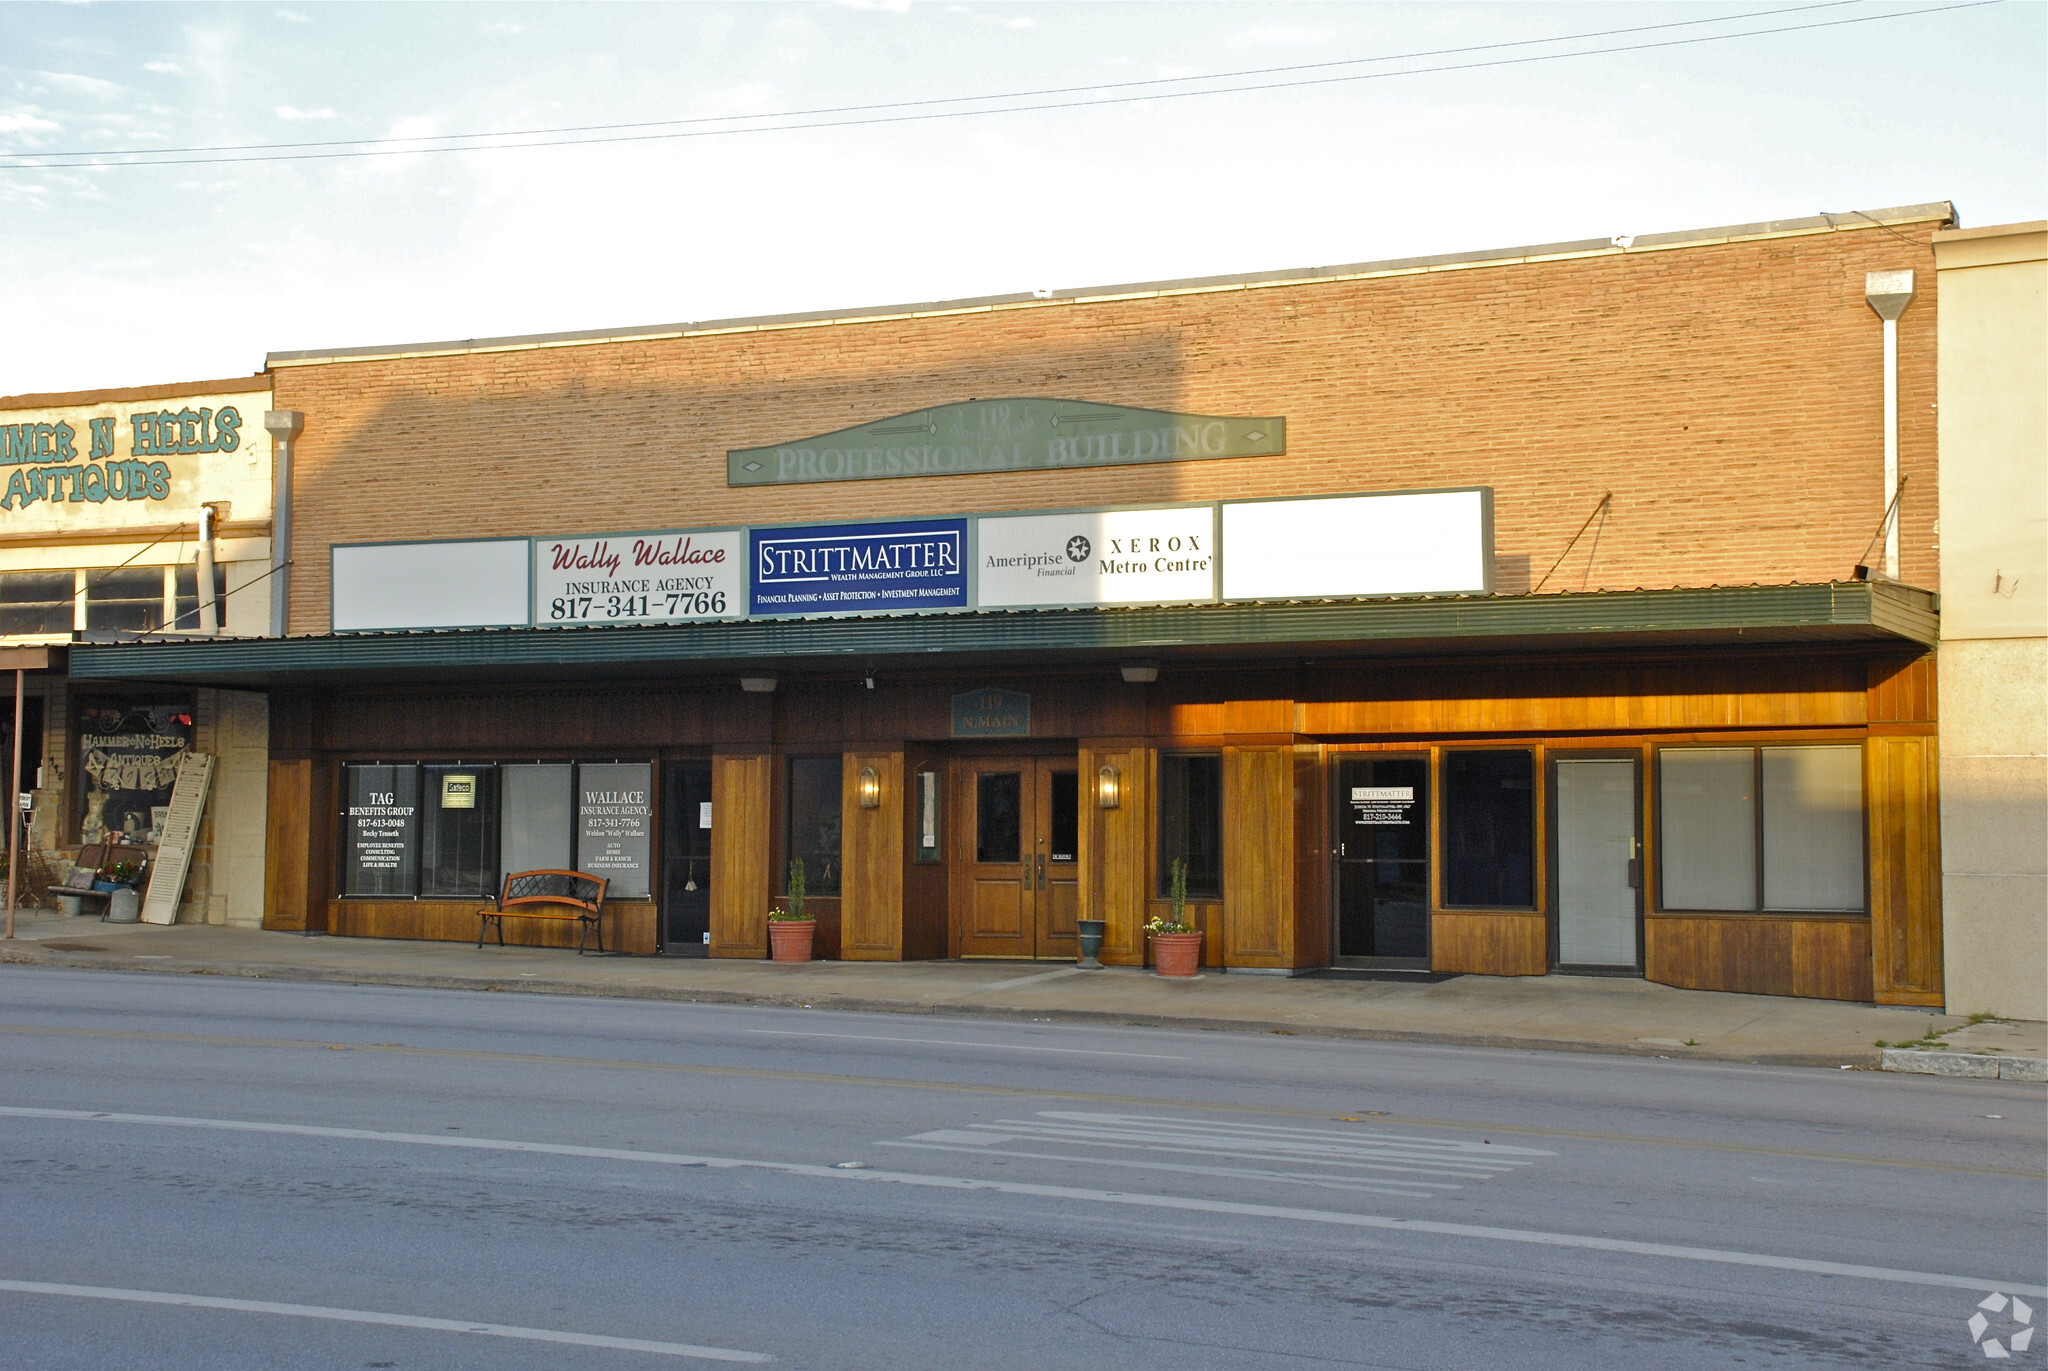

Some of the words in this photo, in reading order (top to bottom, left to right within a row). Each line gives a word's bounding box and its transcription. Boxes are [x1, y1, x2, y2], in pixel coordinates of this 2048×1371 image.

[979, 403, 1010, 425] 119
[89, 417, 117, 460] N
[130, 406, 243, 456] HEELS
[776, 443, 1032, 483] PROFESSIONAL
[1044, 421, 1227, 465] BUILDING
[0, 459, 172, 511] ANTIQUES
[1111, 535, 1200, 554] XEROX
[551, 541, 621, 578] Wally
[632, 537, 726, 566] Wallace
[763, 542, 956, 574] STRITTMATTER
[986, 553, 1063, 570] Ameriprise
[831, 573, 857, 581] WEALTH
[858, 572, 904, 580] MANAGEMENT
[930, 569, 943, 577] LLC
[1037, 566, 1076, 577] Financial
[1099, 559, 1147, 575] Metro
[566, 580, 650, 595] INSURANCE
[656, 577, 714, 592] AGENCY
[757, 594, 787, 604] FINANCIAL
[788, 593, 818, 603] PLANNING
[822, 592, 839, 601] ASSET
[840, 590, 876, 600] PROTECTION
[881, 589, 917, 599] INVESTMENT
[918, 587, 960, 597] MANAGEMENT
[551, 591, 726, 619] 817-341-7766
[978, 714, 1020, 728] MAIN
[82, 734, 129, 750] HAMMER
[135, 734, 146, 749] N
[149, 734, 185, 749] HEELS
[109, 753, 161, 767] ANTIQUES
[370, 792, 394, 805] TAG
[586, 791, 644, 804] WALLACE
[349, 807, 386, 816] BENEFITS
[387, 807, 414, 816] GROUP
[581, 807, 619, 815] INSURANCE
[621, 807, 648, 815] AGENCY
[358, 819, 405, 827] 817-613-0048
[588, 819, 640, 827] 817-341-7766
